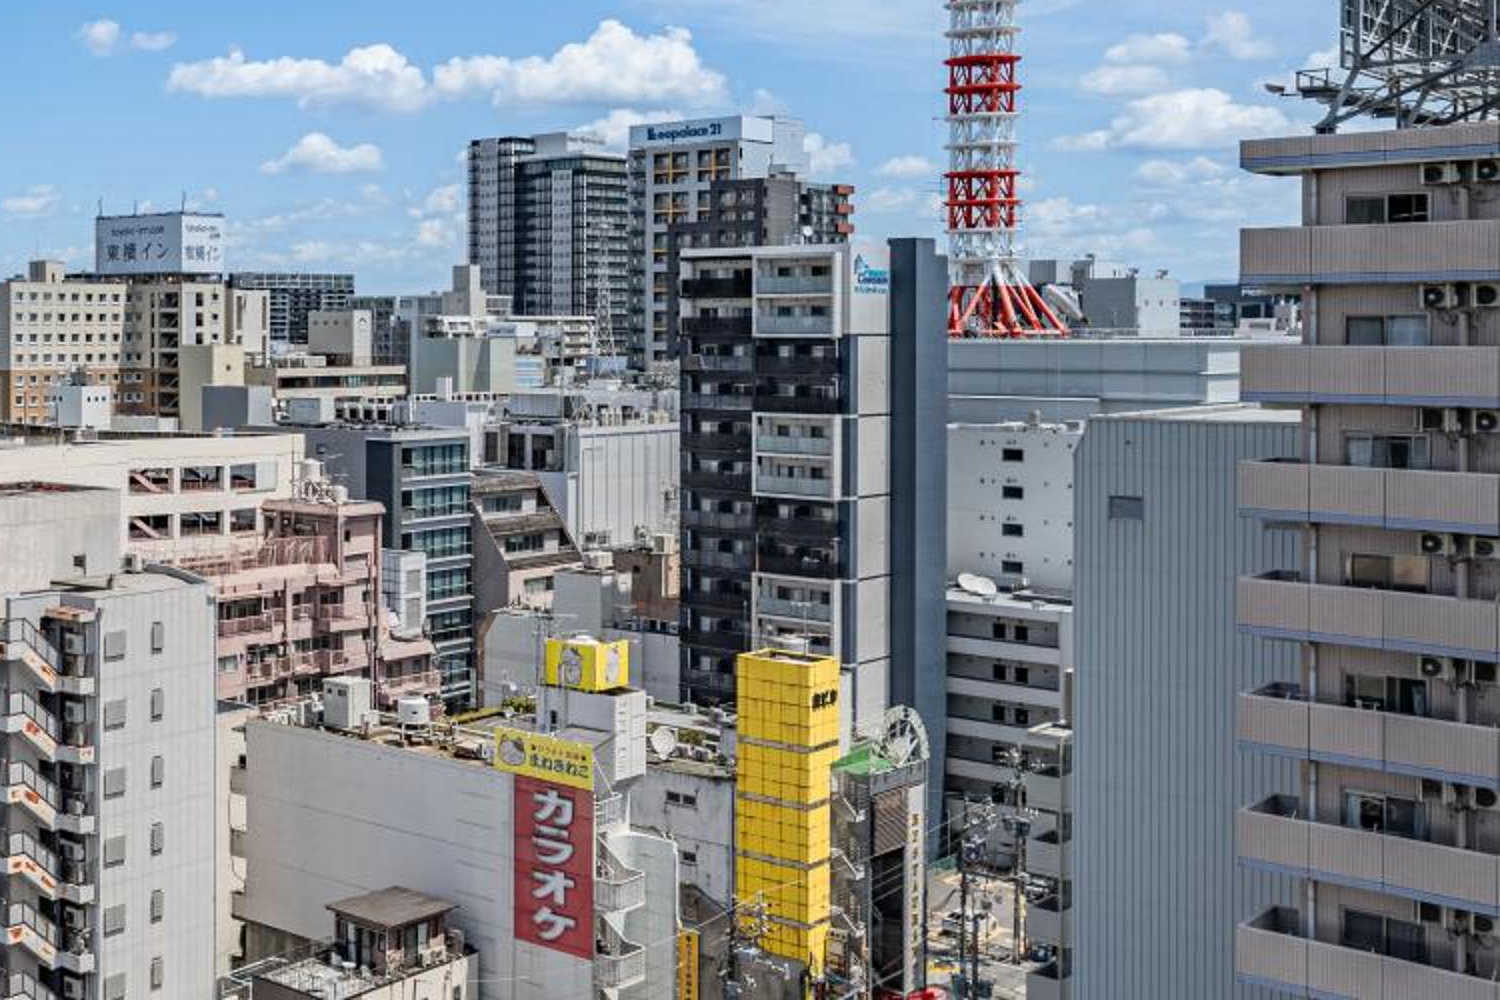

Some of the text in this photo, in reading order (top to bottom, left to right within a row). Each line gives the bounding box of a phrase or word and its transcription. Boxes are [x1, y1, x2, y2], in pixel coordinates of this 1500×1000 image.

[106, 242, 169, 262] 東横イン
[531, 788, 577, 941] カラオケ
